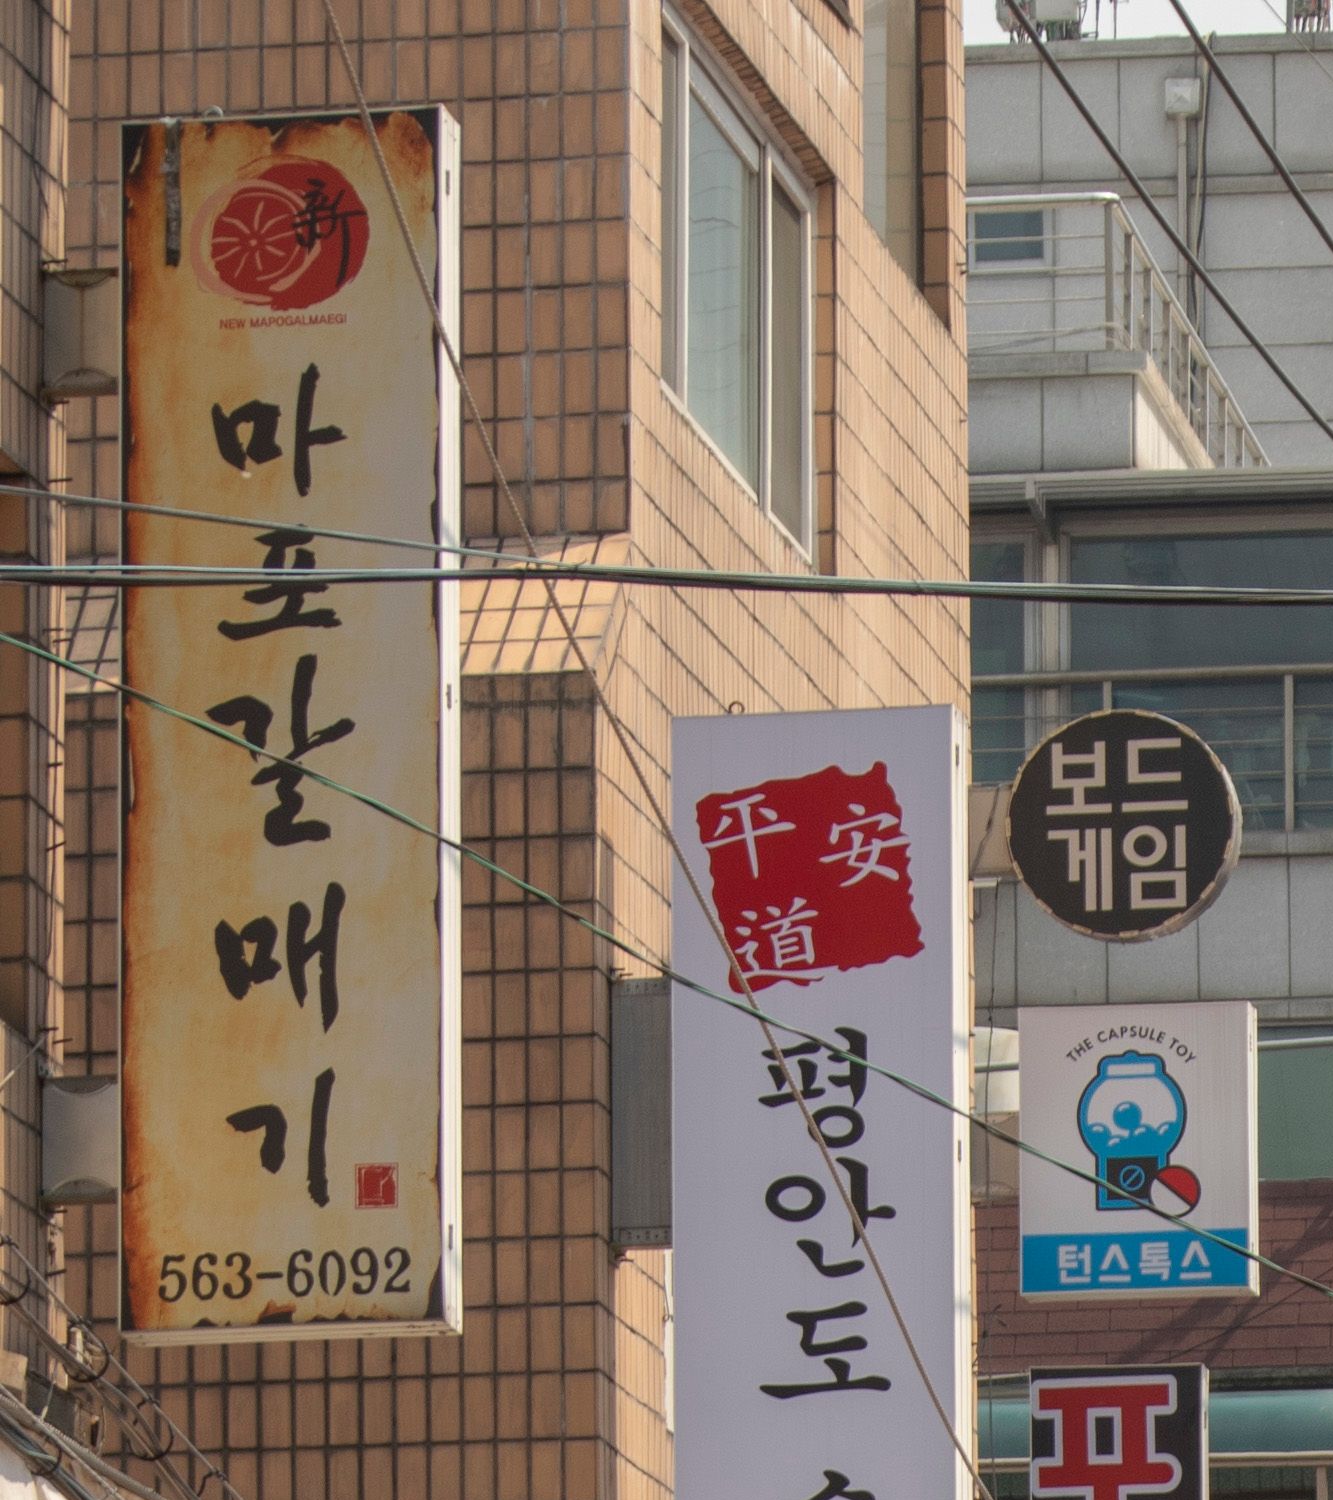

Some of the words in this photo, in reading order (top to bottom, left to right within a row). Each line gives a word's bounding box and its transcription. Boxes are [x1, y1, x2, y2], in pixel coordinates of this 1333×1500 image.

[218, 315, 246, 330] NEW
[248, 313, 348, 330] MAPOGALMAEGI
[205, 362, 356, 1208] 마포갈매기
[1045, 736, 1190, 816] 보드
[1046, 823, 1188, 912] 게임
[1065, 1035, 1095, 1064] THE
[1096, 1024, 1167, 1045] CAPSULE
[1168, 1036, 1198, 1065] TOY
[756, 1025, 899, 1402] 평안도
[157, 1246, 413, 1306] 563-6092
[1056, 1239, 1213, 1286] 턴스톡스
